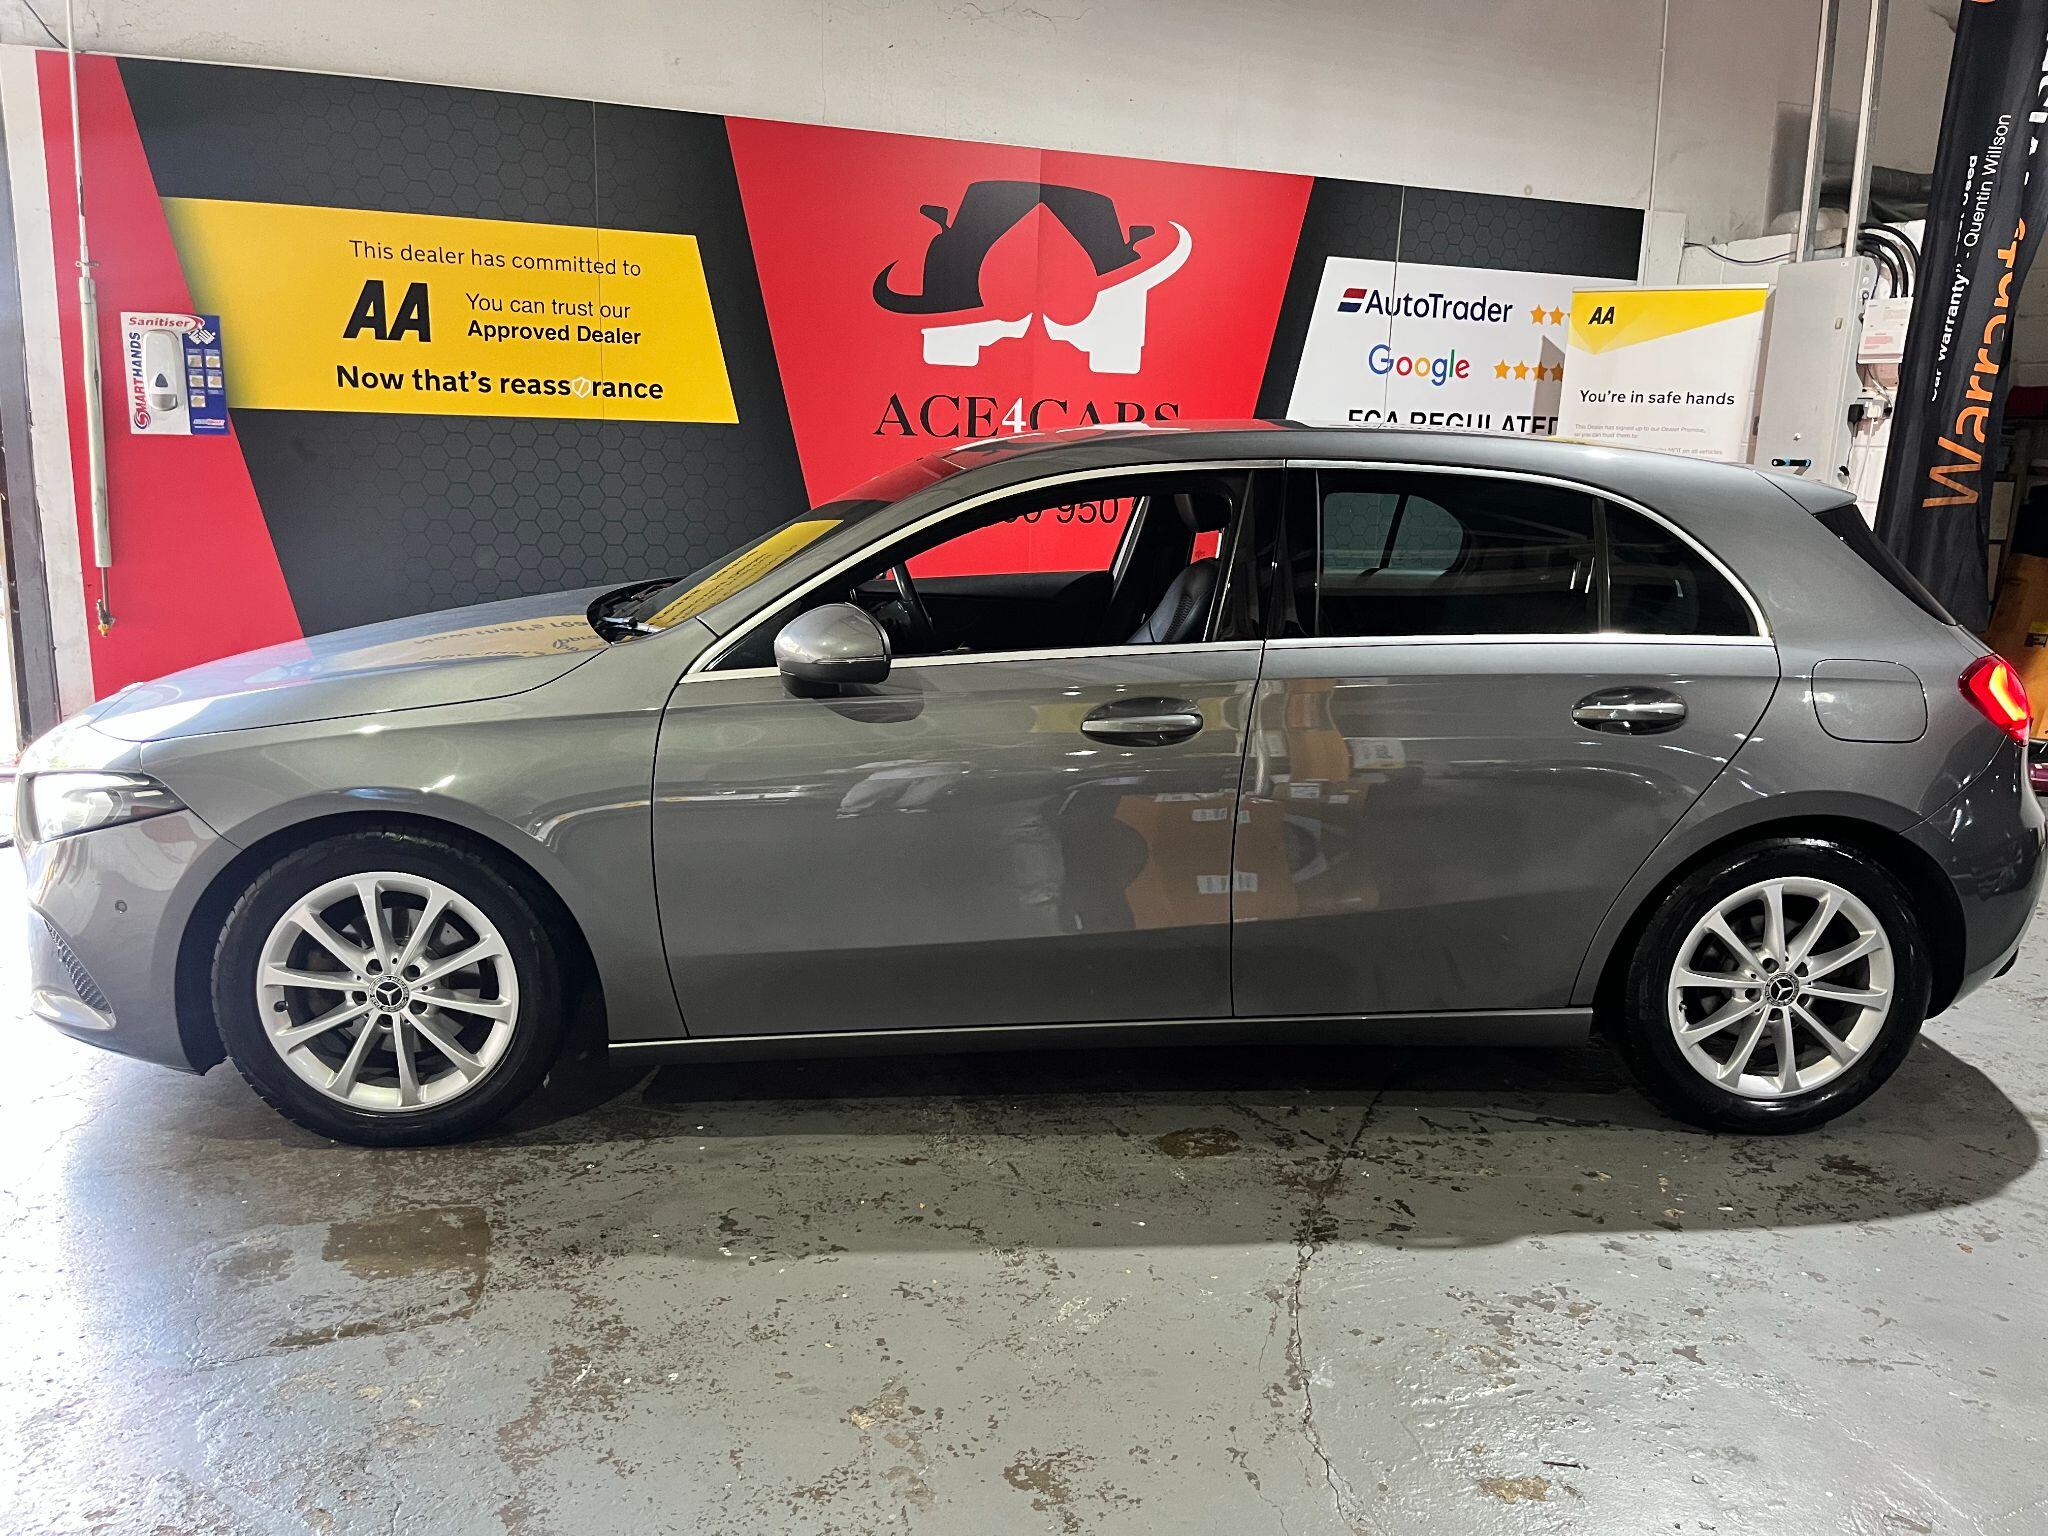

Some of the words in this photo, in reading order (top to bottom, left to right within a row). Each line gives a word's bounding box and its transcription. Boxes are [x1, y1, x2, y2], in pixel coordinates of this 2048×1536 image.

[1963, 181, 1994, 247] Quentin
[1982, 114, 2012, 176] Willson
[349, 240, 394, 260] This
[400, 244, 465, 265] dealer
[471, 249, 506, 268] has
[512, 255, 616, 275] committed
[622, 260, 642, 277] to
[342, 279, 432, 343] AA
[466, 293, 503, 312] You
[509, 298, 545, 314] can
[551, 299, 594, 317] trust
[600, 303, 631, 319] our
[1365, 289, 1513, 323] AutoTrader
[1588, 306, 1615, 325] AA
[128, 316, 192, 328] Sanitiser
[467, 320, 571, 342] Approved
[577, 325, 642, 345] Dealer
[1368, 343, 1470, 387] Google
[336, 365, 405, 390] Now
[411, 368, 492, 394] that’s
[1579, 389, 1626, 403] You’re
[1630, 390, 1644, 403] in
[1648, 390, 1682, 404] safe
[1685, 392, 1735, 405] hands
[1056, 498, 1119, 524] 950
